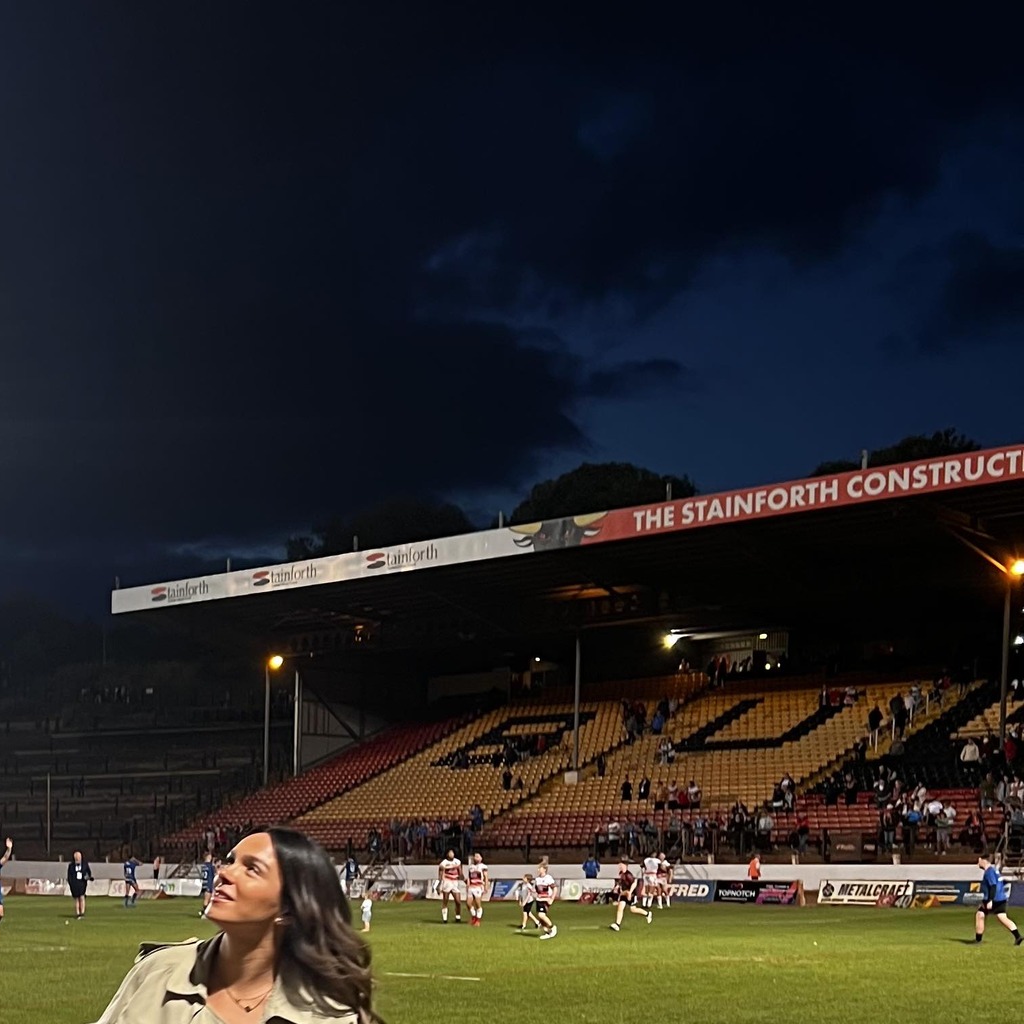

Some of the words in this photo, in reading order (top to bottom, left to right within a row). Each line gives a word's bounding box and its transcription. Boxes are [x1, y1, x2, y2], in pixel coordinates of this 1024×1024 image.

[633, 505, 675, 532] THE
[681, 479, 839, 525] STAINFORTH
[847, 447, 1024, 499] CONSTRUCT
[669, 884, 710, 897] FRED
[718, 889, 756, 898] TOPNOTCH
[838, 881, 911, 896] METALCRAFT
